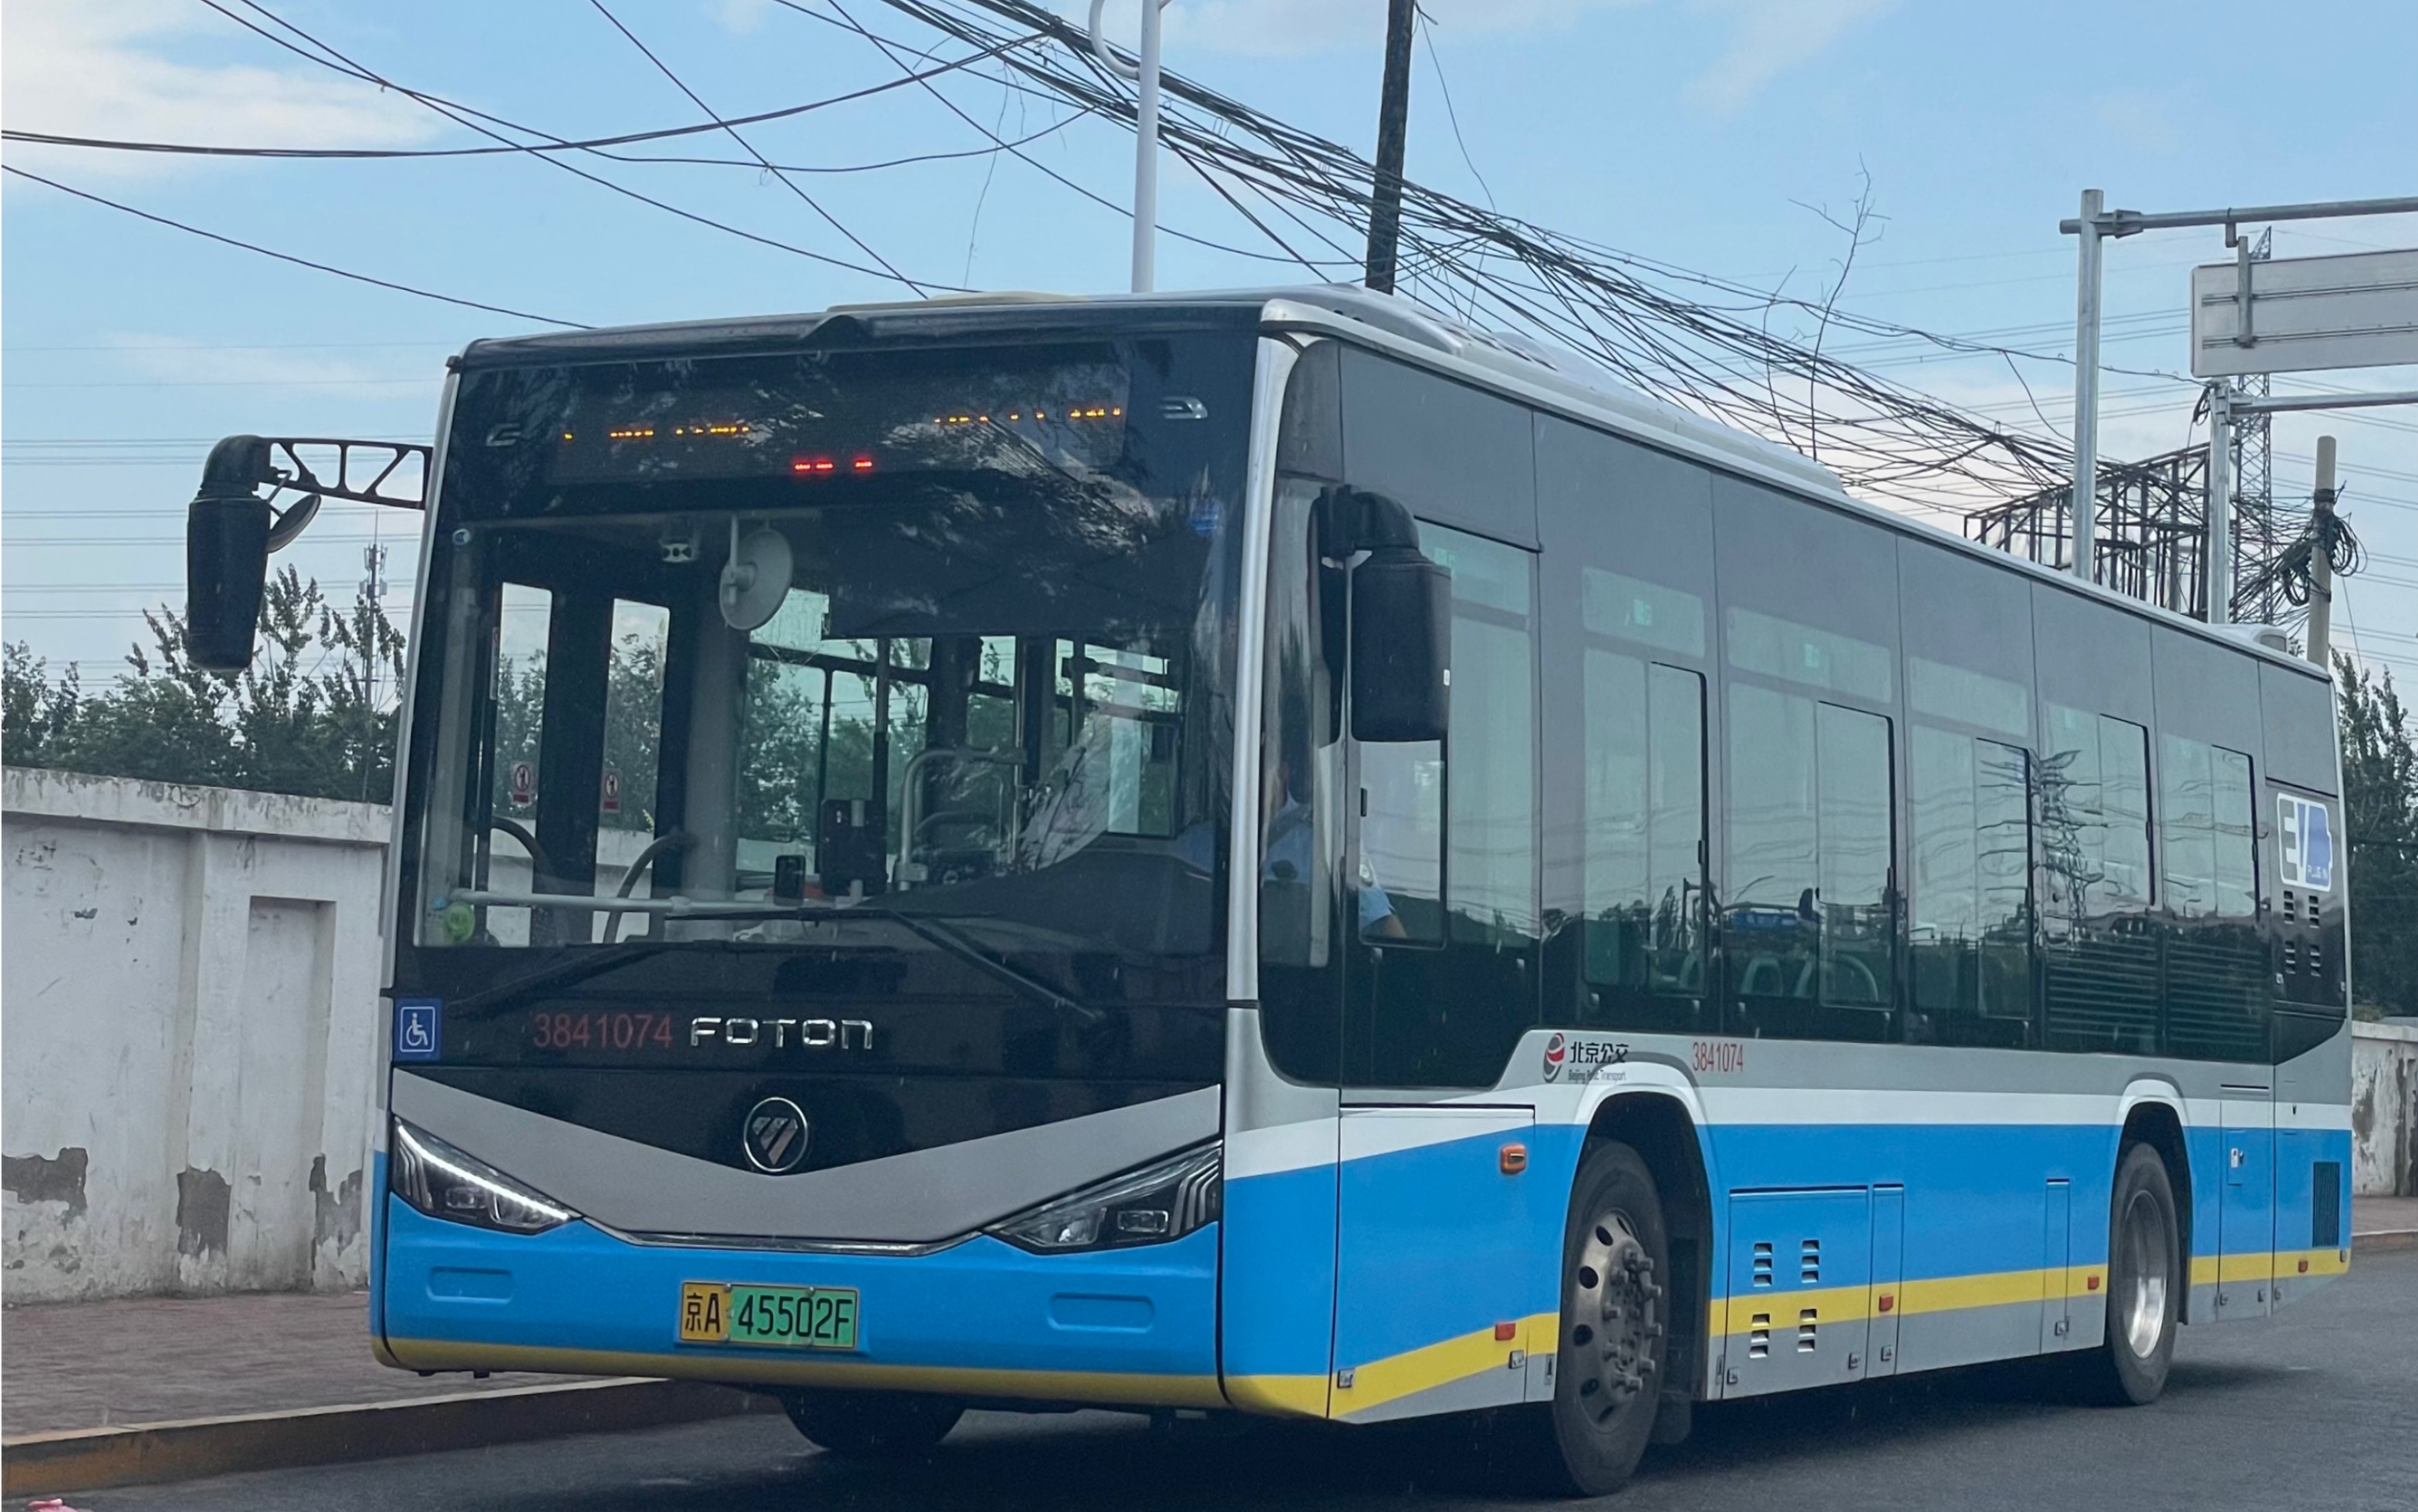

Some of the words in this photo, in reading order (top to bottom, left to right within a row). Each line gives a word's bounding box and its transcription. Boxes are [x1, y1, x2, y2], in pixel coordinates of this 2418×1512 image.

[533, 1013, 673, 1049] 3841074
[1569, 1041, 1629, 1064] 北京公交
[1693, 1042, 1744, 1072] 3841074
